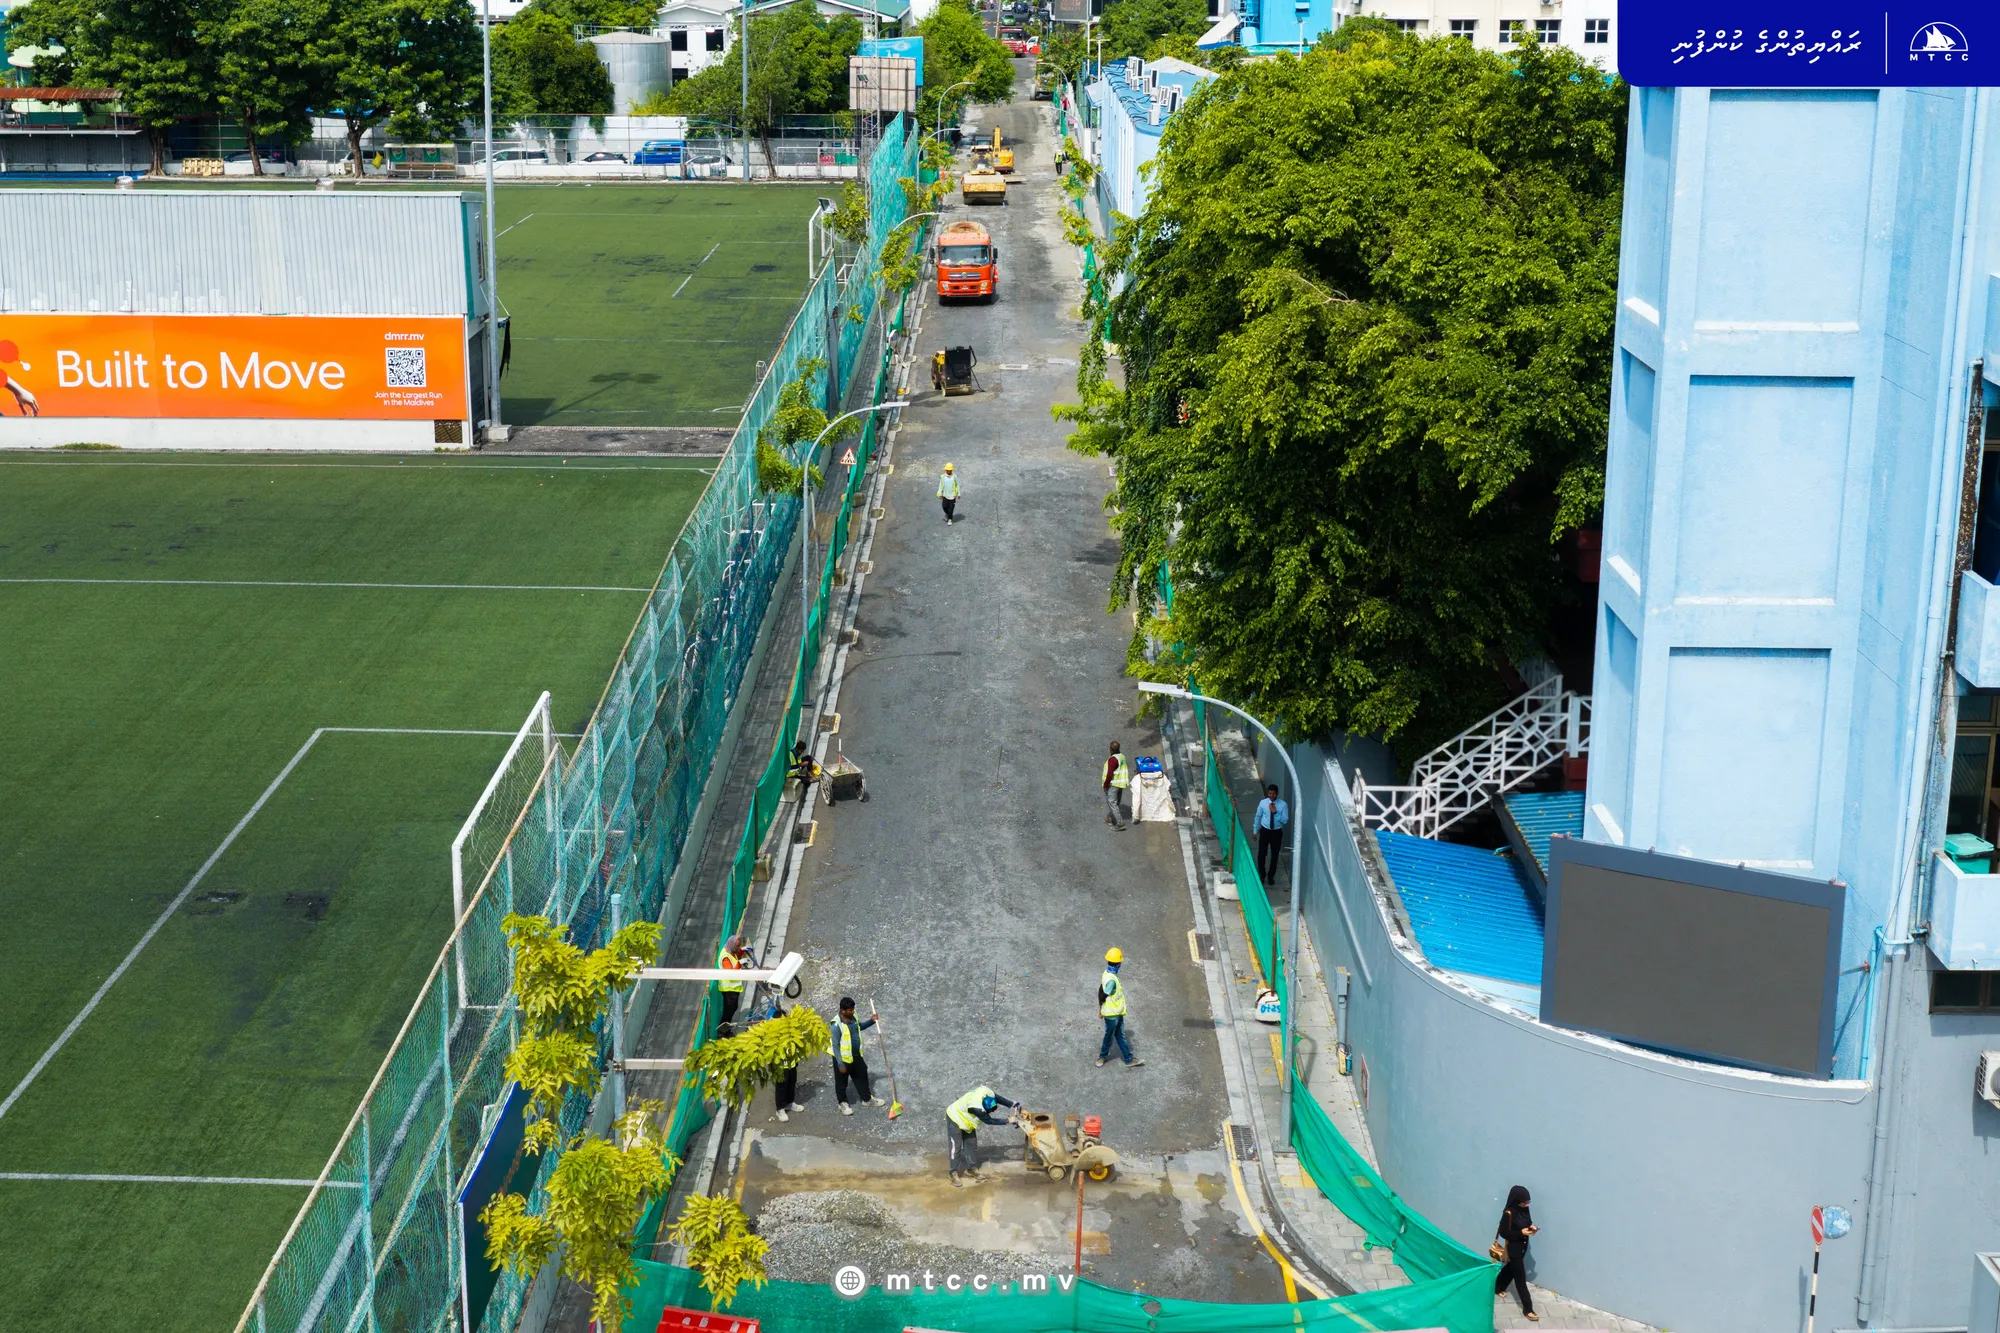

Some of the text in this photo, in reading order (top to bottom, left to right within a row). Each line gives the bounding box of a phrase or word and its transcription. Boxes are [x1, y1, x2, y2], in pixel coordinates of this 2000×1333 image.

[384, 332, 425, 341] dmrr.mv
[56, 350, 346, 390] Built to Move
[402, 392, 428, 400] Largest
